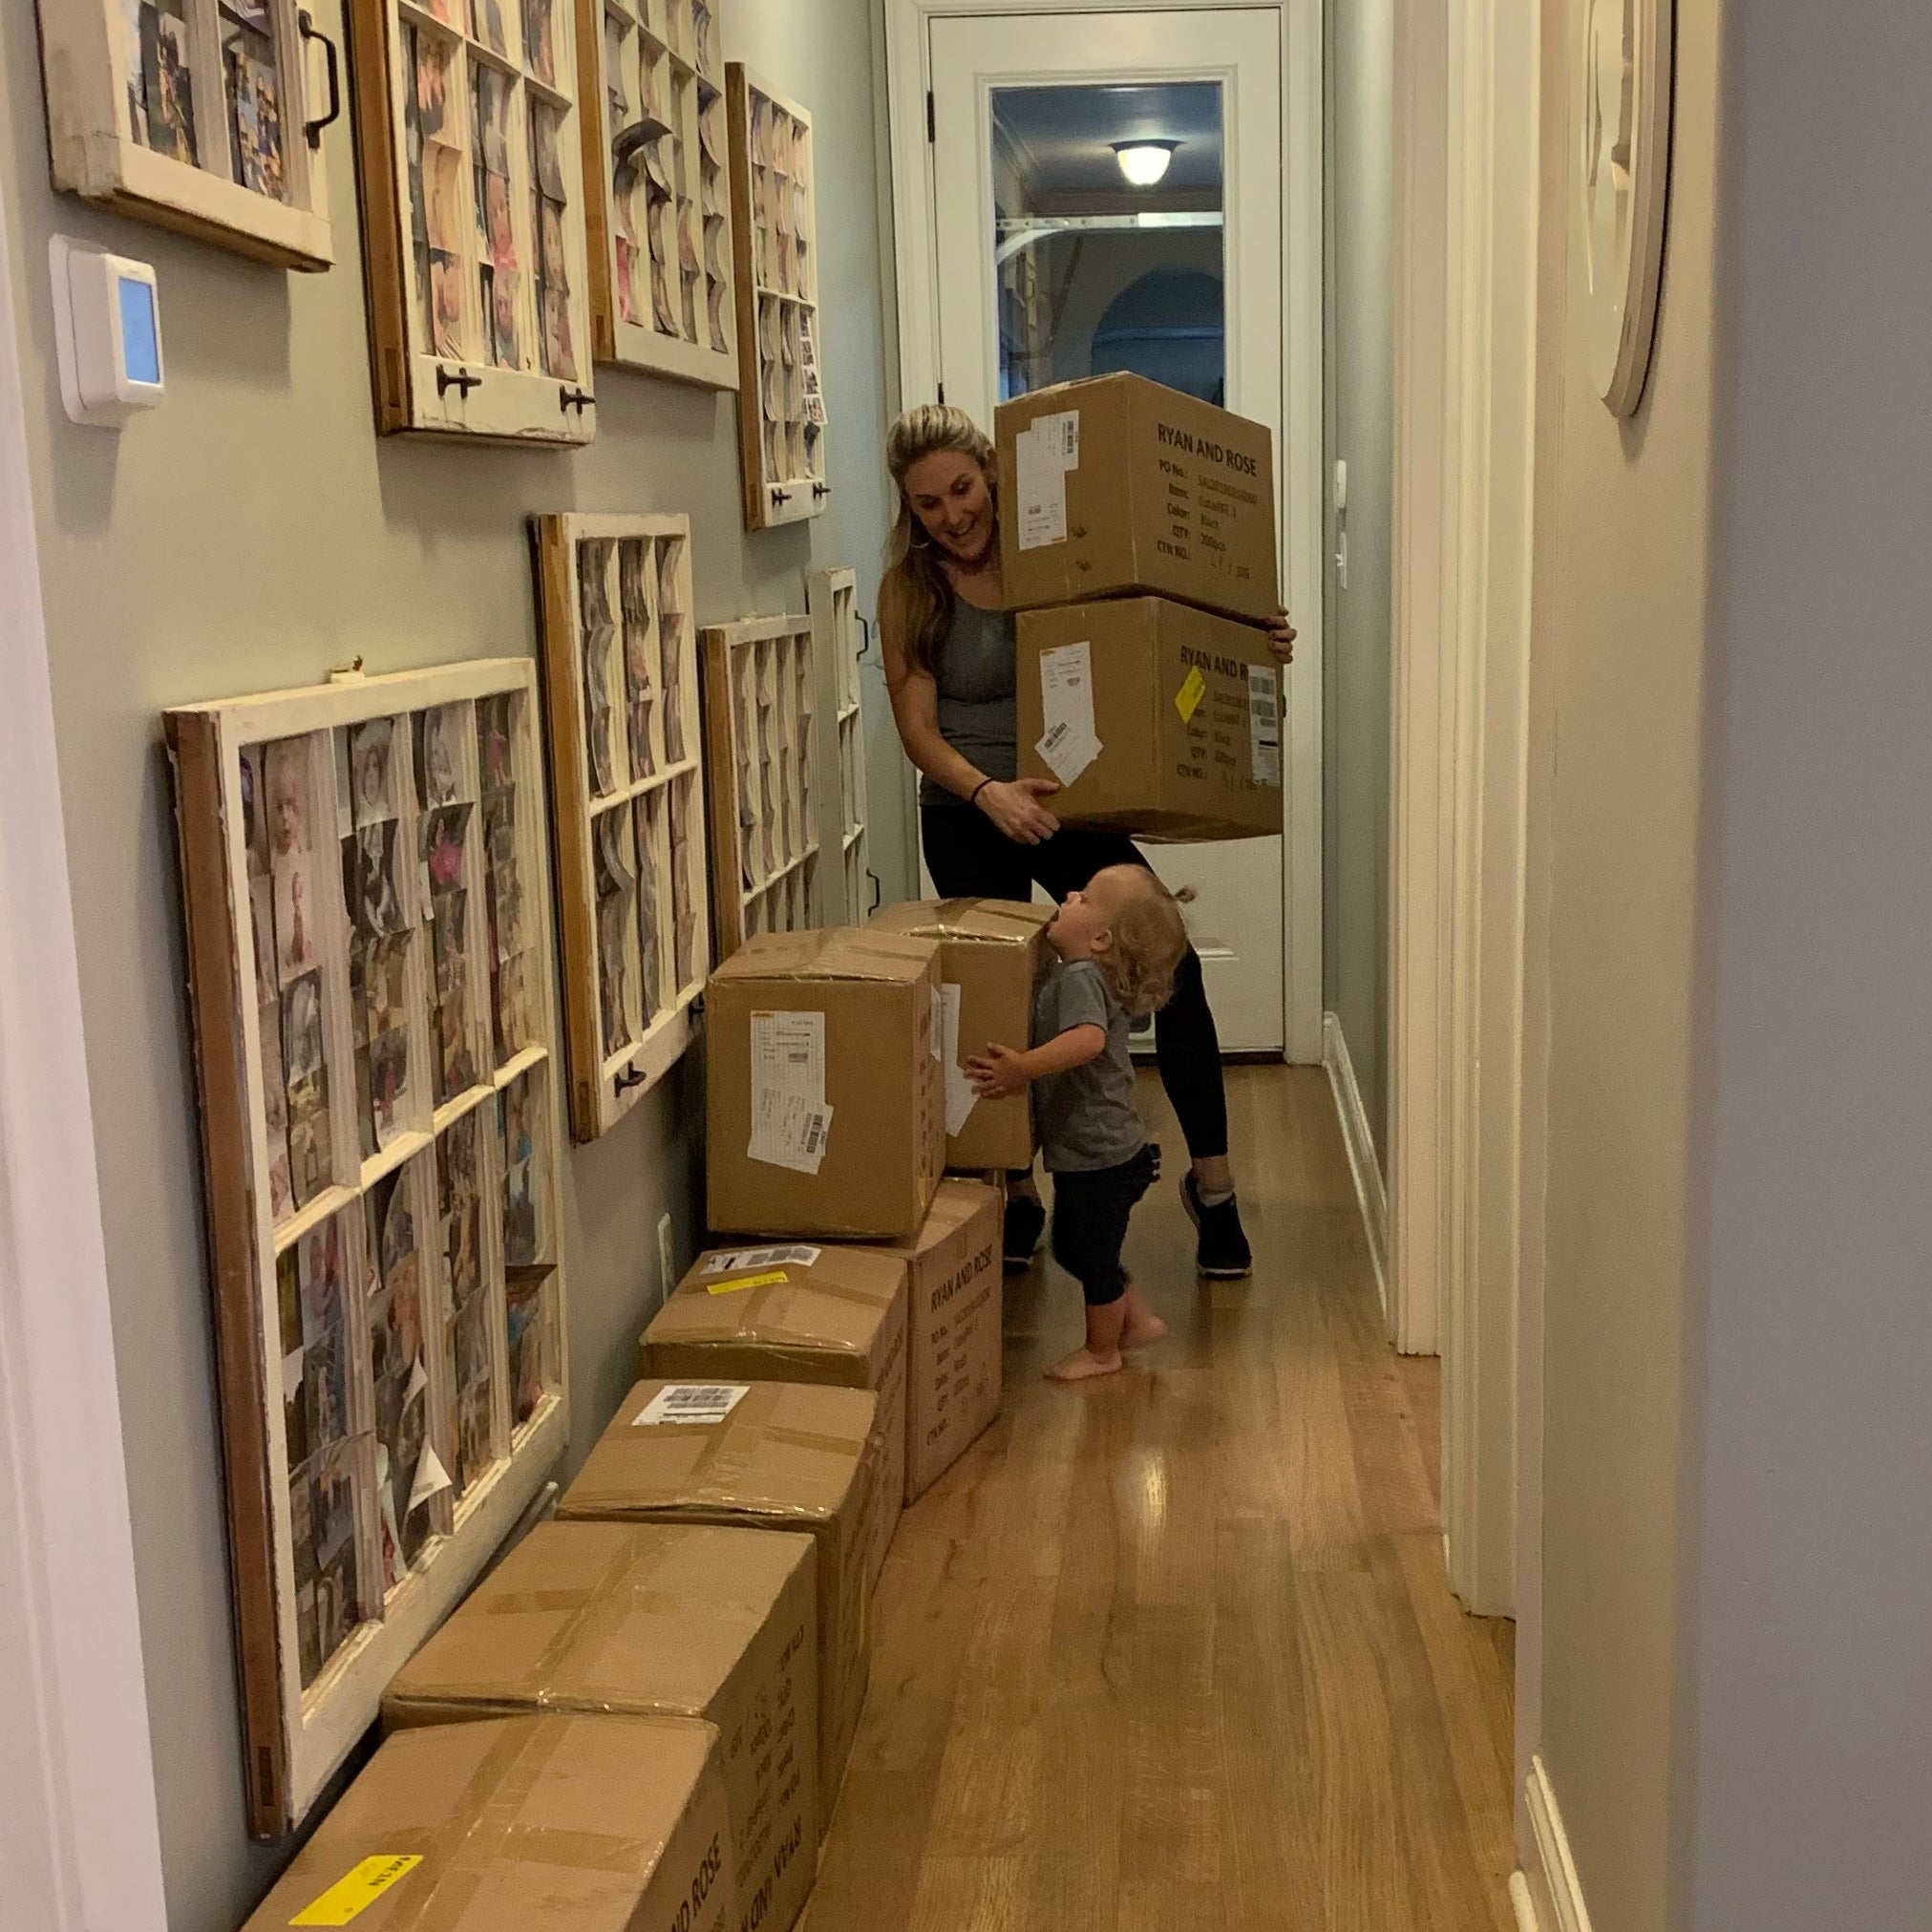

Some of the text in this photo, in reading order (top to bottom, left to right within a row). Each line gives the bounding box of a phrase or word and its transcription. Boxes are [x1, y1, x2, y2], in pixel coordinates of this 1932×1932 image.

[1157, 422, 1257, 477] RYAN AND ROSE
[1158, 458, 1171, 473] PO
[1179, 645, 1211, 670] RYAN
[1214, 656, 1238, 678] AND
[931, 1277, 955, 1313] RYAN
[955, 1261, 973, 1294] AND
[973, 1243, 992, 1274] ROSE
[691, 1832, 721, 1918] ROSE
